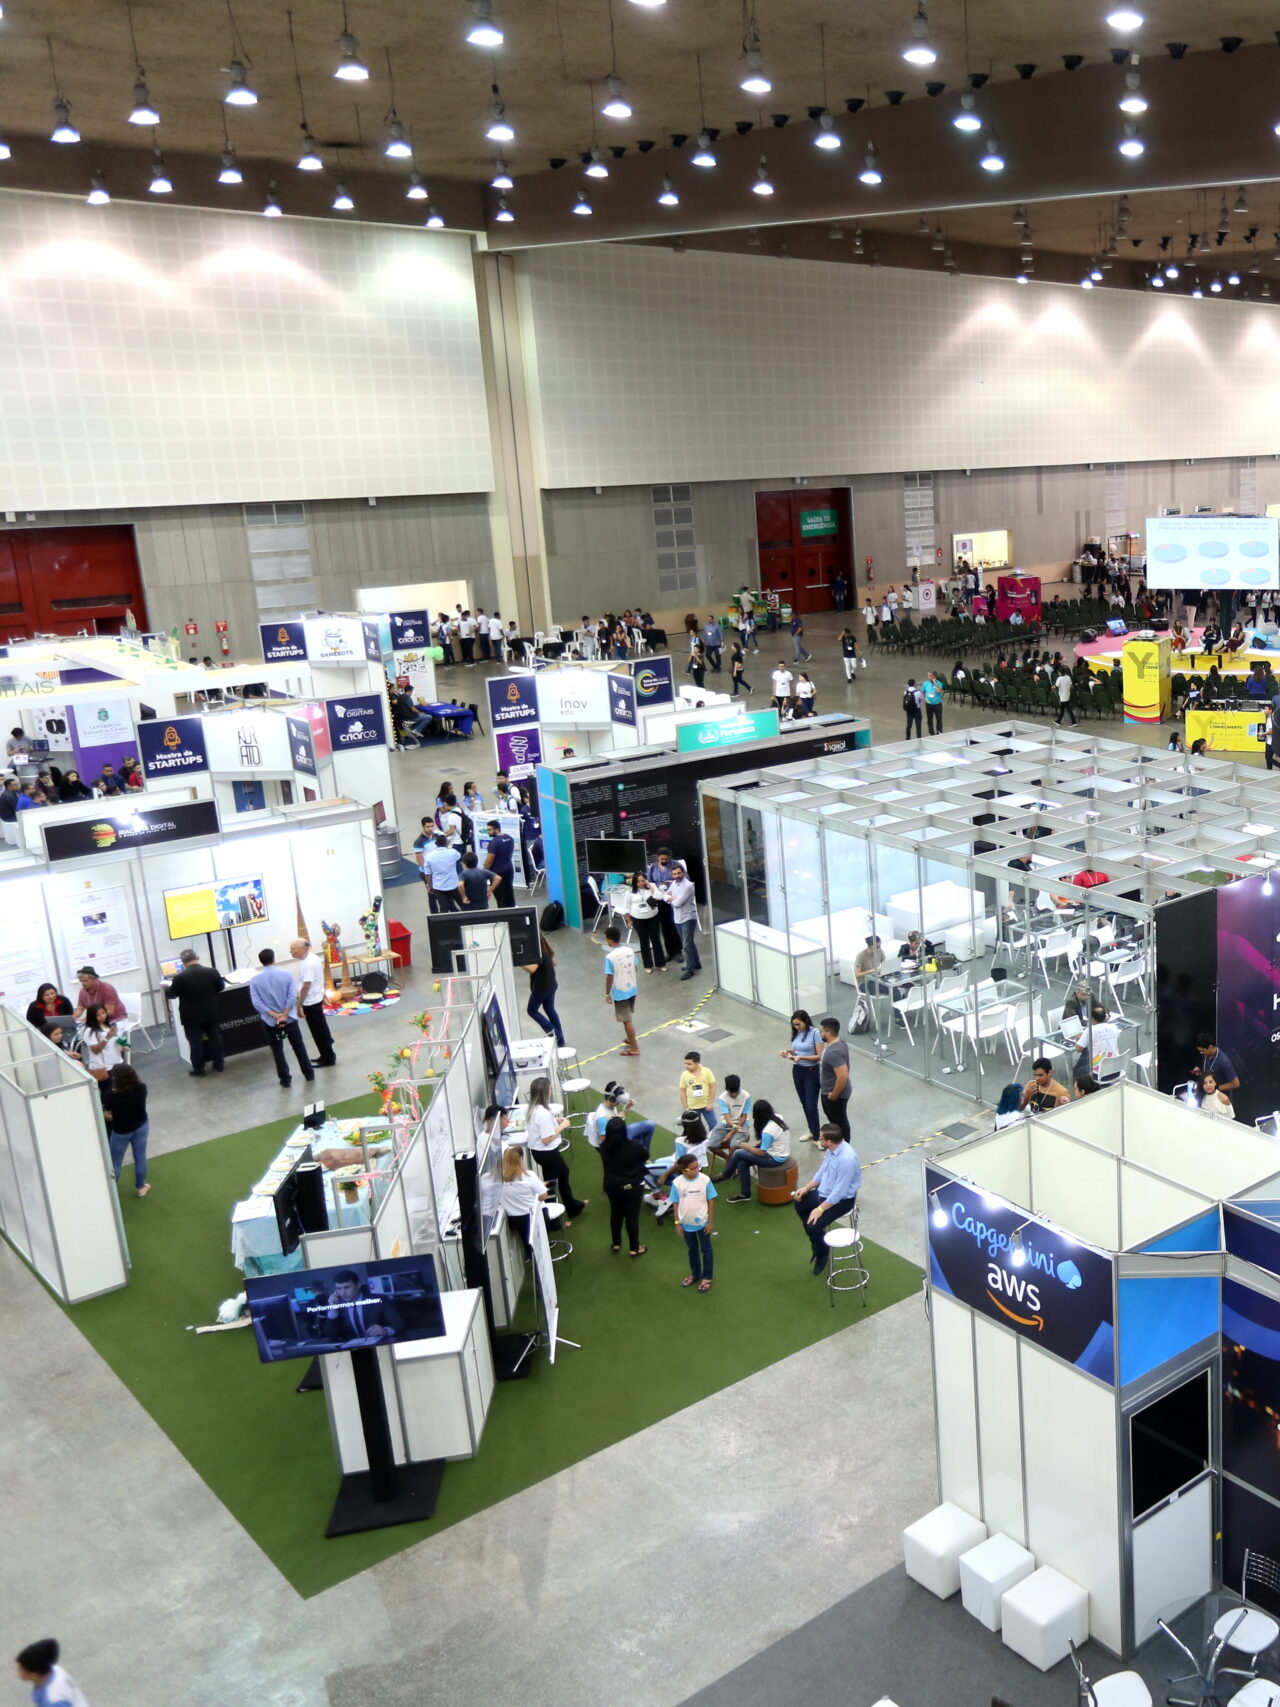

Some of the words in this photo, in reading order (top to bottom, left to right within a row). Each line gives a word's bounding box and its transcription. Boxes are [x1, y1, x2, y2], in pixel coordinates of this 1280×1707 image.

[267, 648, 304, 659] STARTUPS
[320, 650, 354, 658] GAMEBOTS
[561, 698, 587, 709] Inov
[346, 708, 375, 718] DIGITAIS
[495, 708, 536, 721] STARTUPS
[156, 752, 181, 761] Mostra
[148, 755, 204, 771] STARTUPS
[118, 825, 150, 837] IRACA
[150, 821, 176, 831] DIGITAL
[987, 1262, 1041, 1312] aws
[307, 1301, 355, 1314] Performarmos
[355, 1298, 382, 1307] melhor.
